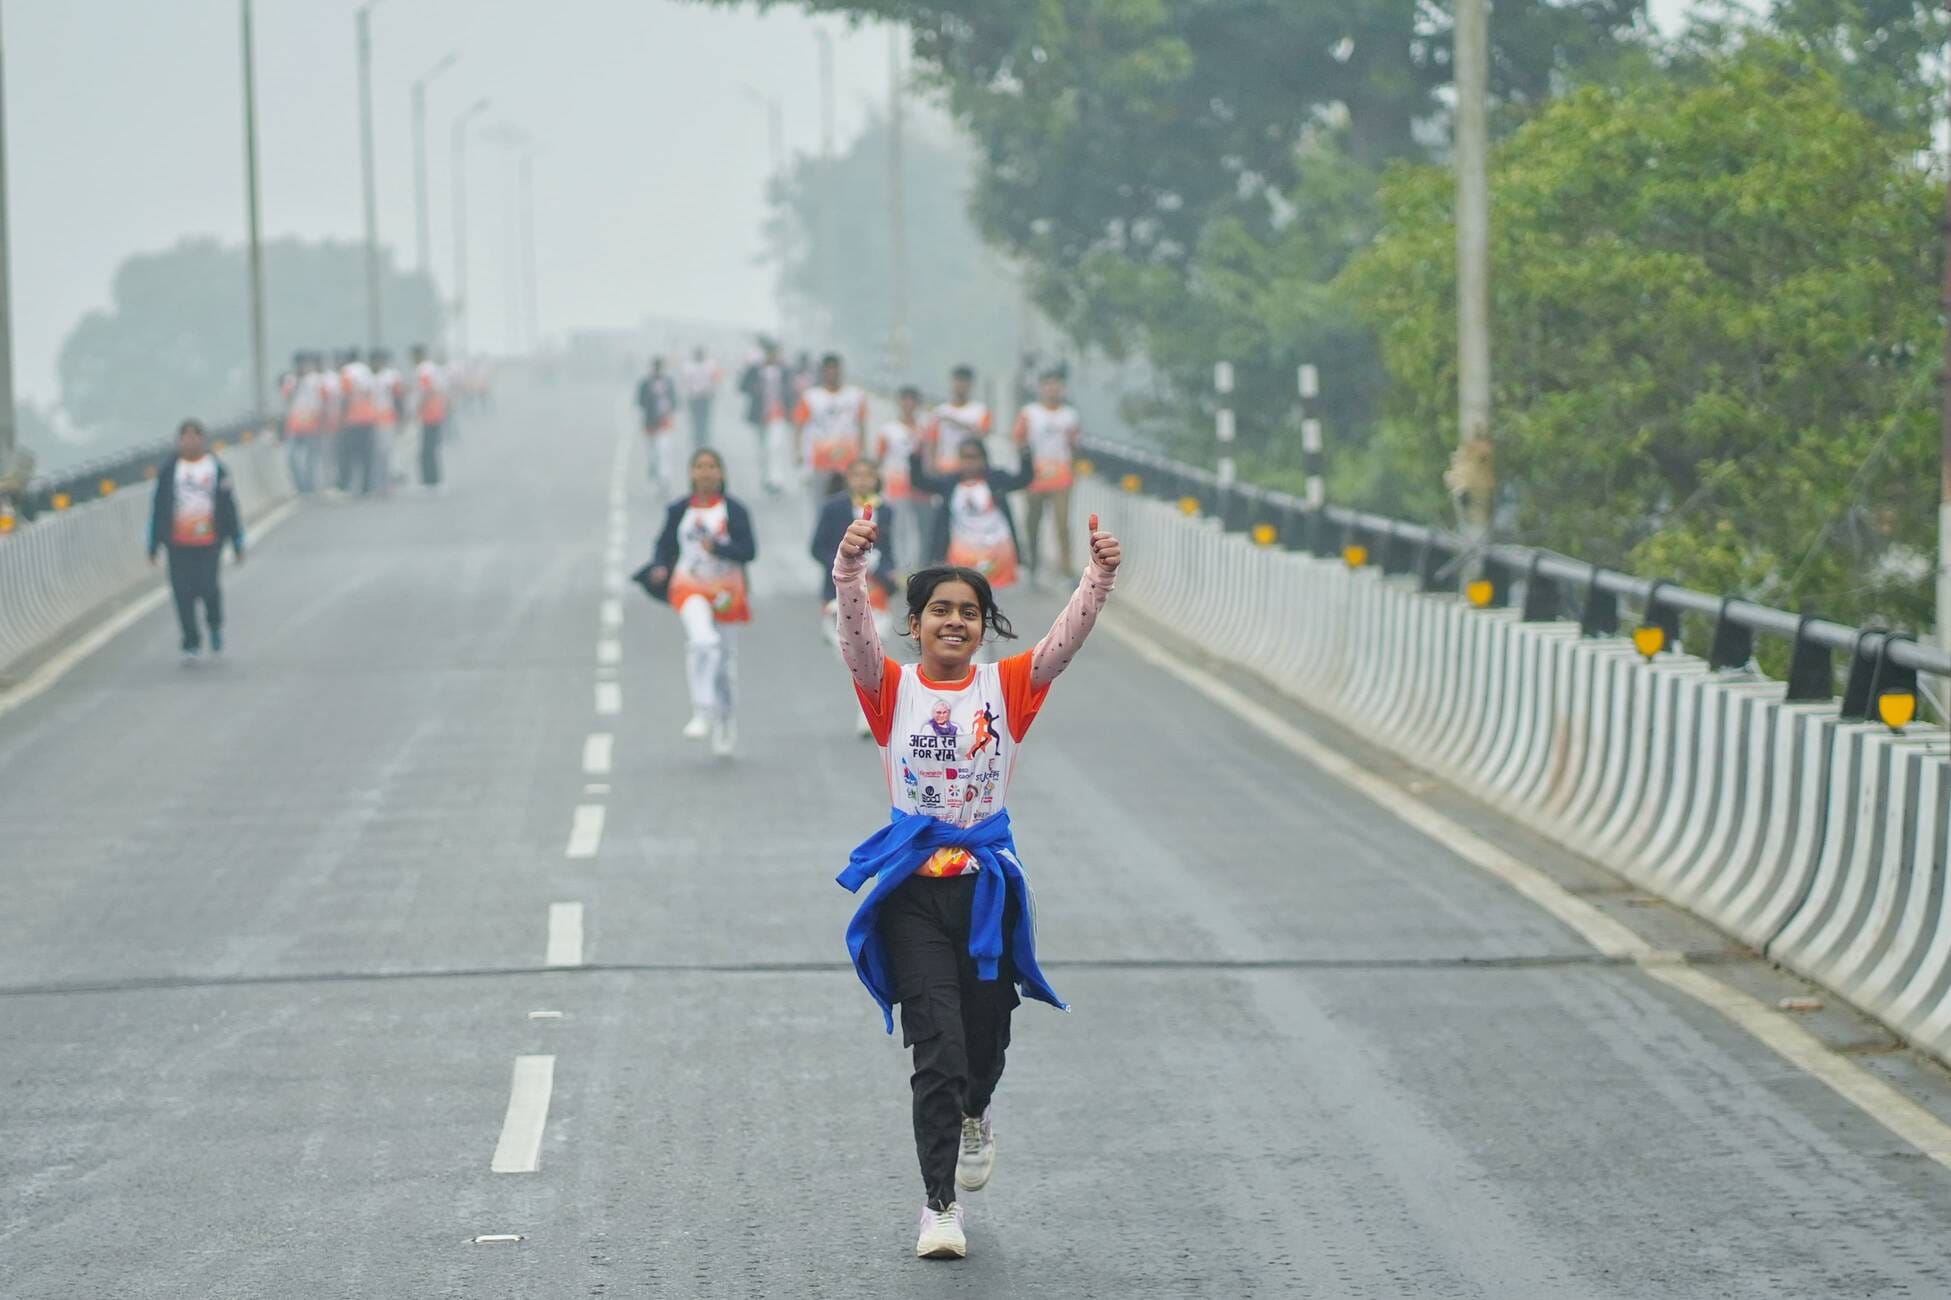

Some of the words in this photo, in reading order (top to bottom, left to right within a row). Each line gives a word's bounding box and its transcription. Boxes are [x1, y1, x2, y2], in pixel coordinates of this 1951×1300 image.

[909, 734, 938, 748] अटल
[940, 735, 957, 748] रन
[913, 749, 932, 759] FOR
[934, 749, 956, 761] राम
